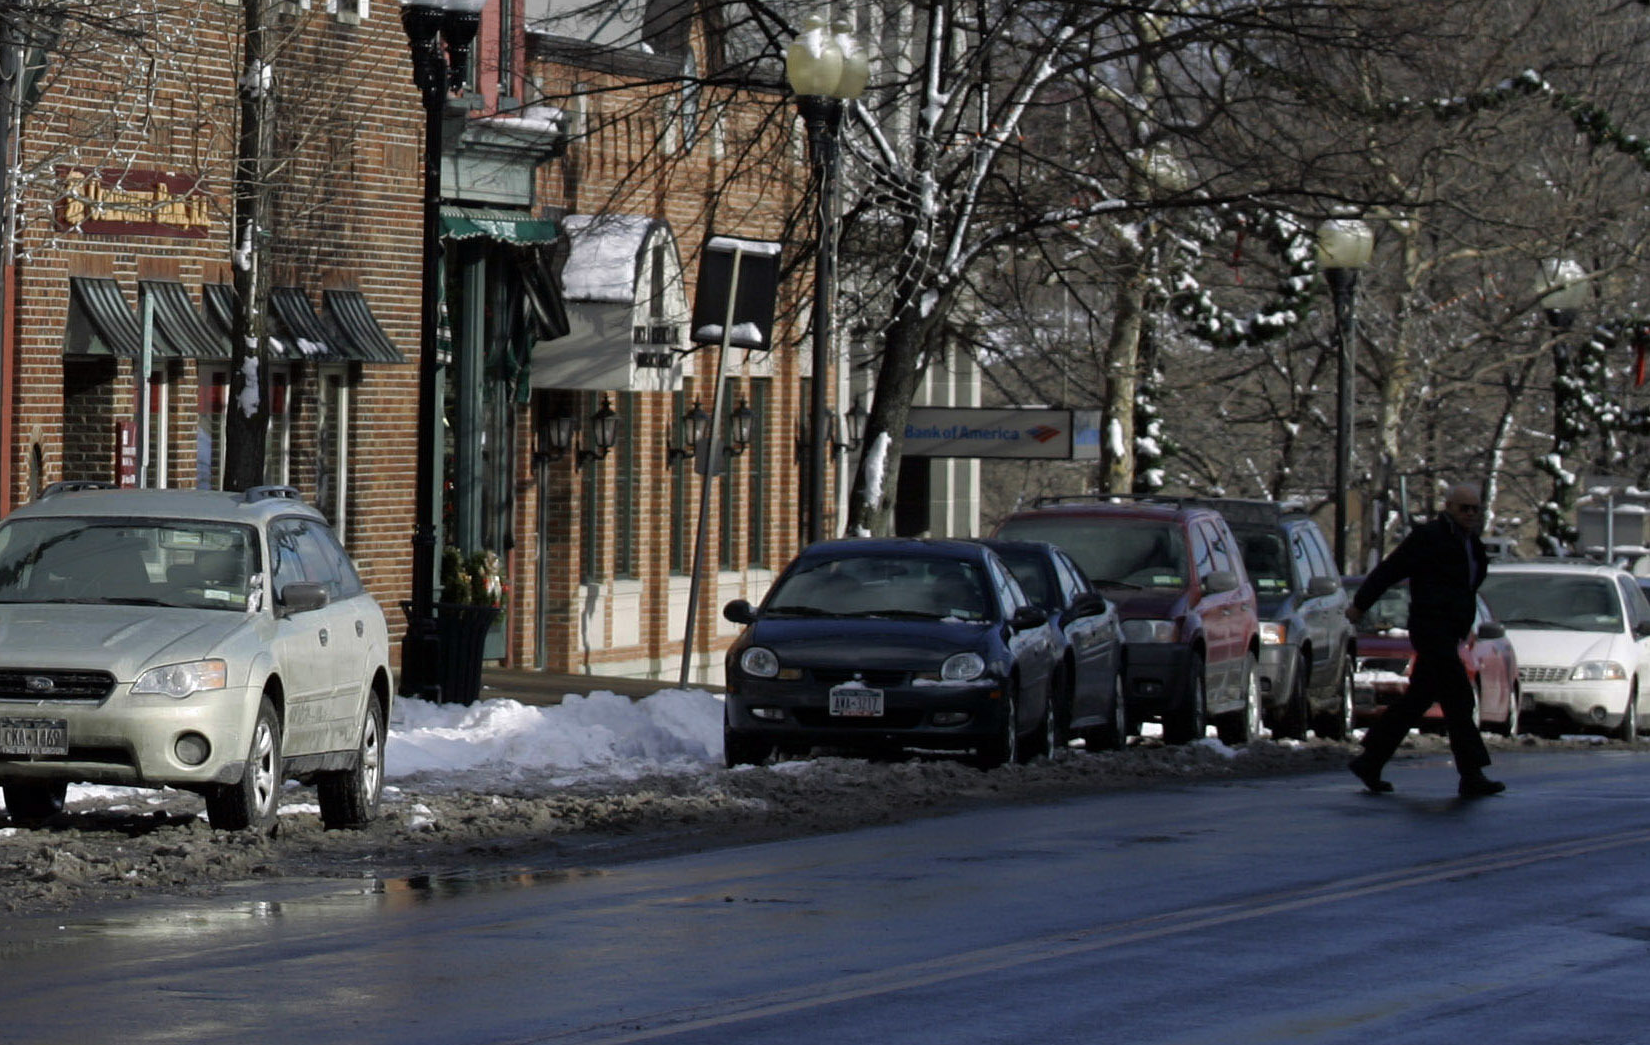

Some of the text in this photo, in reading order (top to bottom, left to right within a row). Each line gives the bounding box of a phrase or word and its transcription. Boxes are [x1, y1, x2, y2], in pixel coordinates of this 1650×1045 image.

[904, 424, 1020, 441] Bank of America
